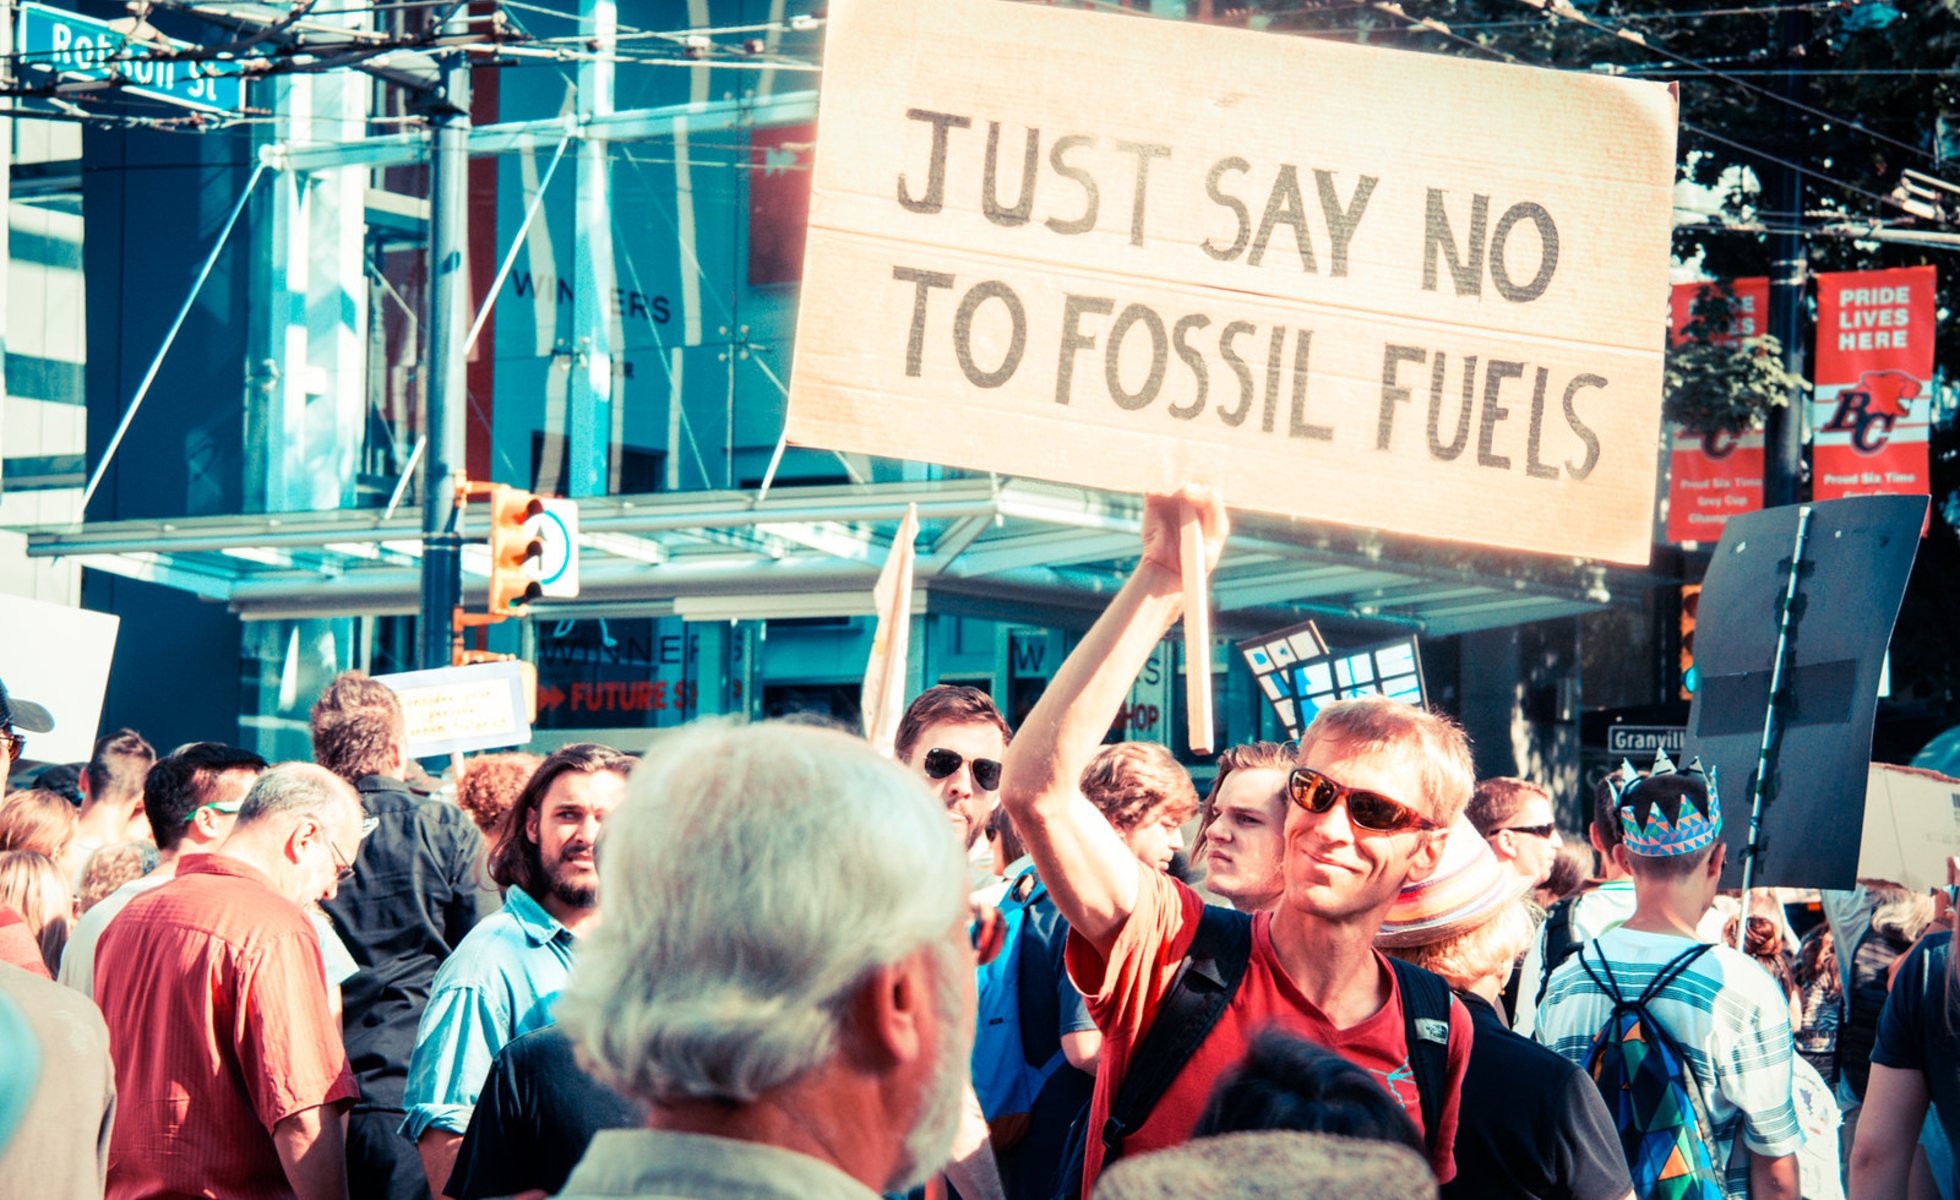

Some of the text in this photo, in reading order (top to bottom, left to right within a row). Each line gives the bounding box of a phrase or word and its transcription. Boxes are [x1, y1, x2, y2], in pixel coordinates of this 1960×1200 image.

[897, 108, 1560, 303] JUST SAY NO
[513, 270, 672, 325] WINERS
[1838, 286, 1911, 308] PRIDE
[1838, 307, 1910, 330] LIVES
[1837, 329, 1908, 352] HERE
[892, 265, 1609, 481] TO FOSSIL FUELS
[1822, 389, 1899, 454] BC
[571, 681, 667, 711] FUTURE
[1614, 730, 1685, 750] Granvill
